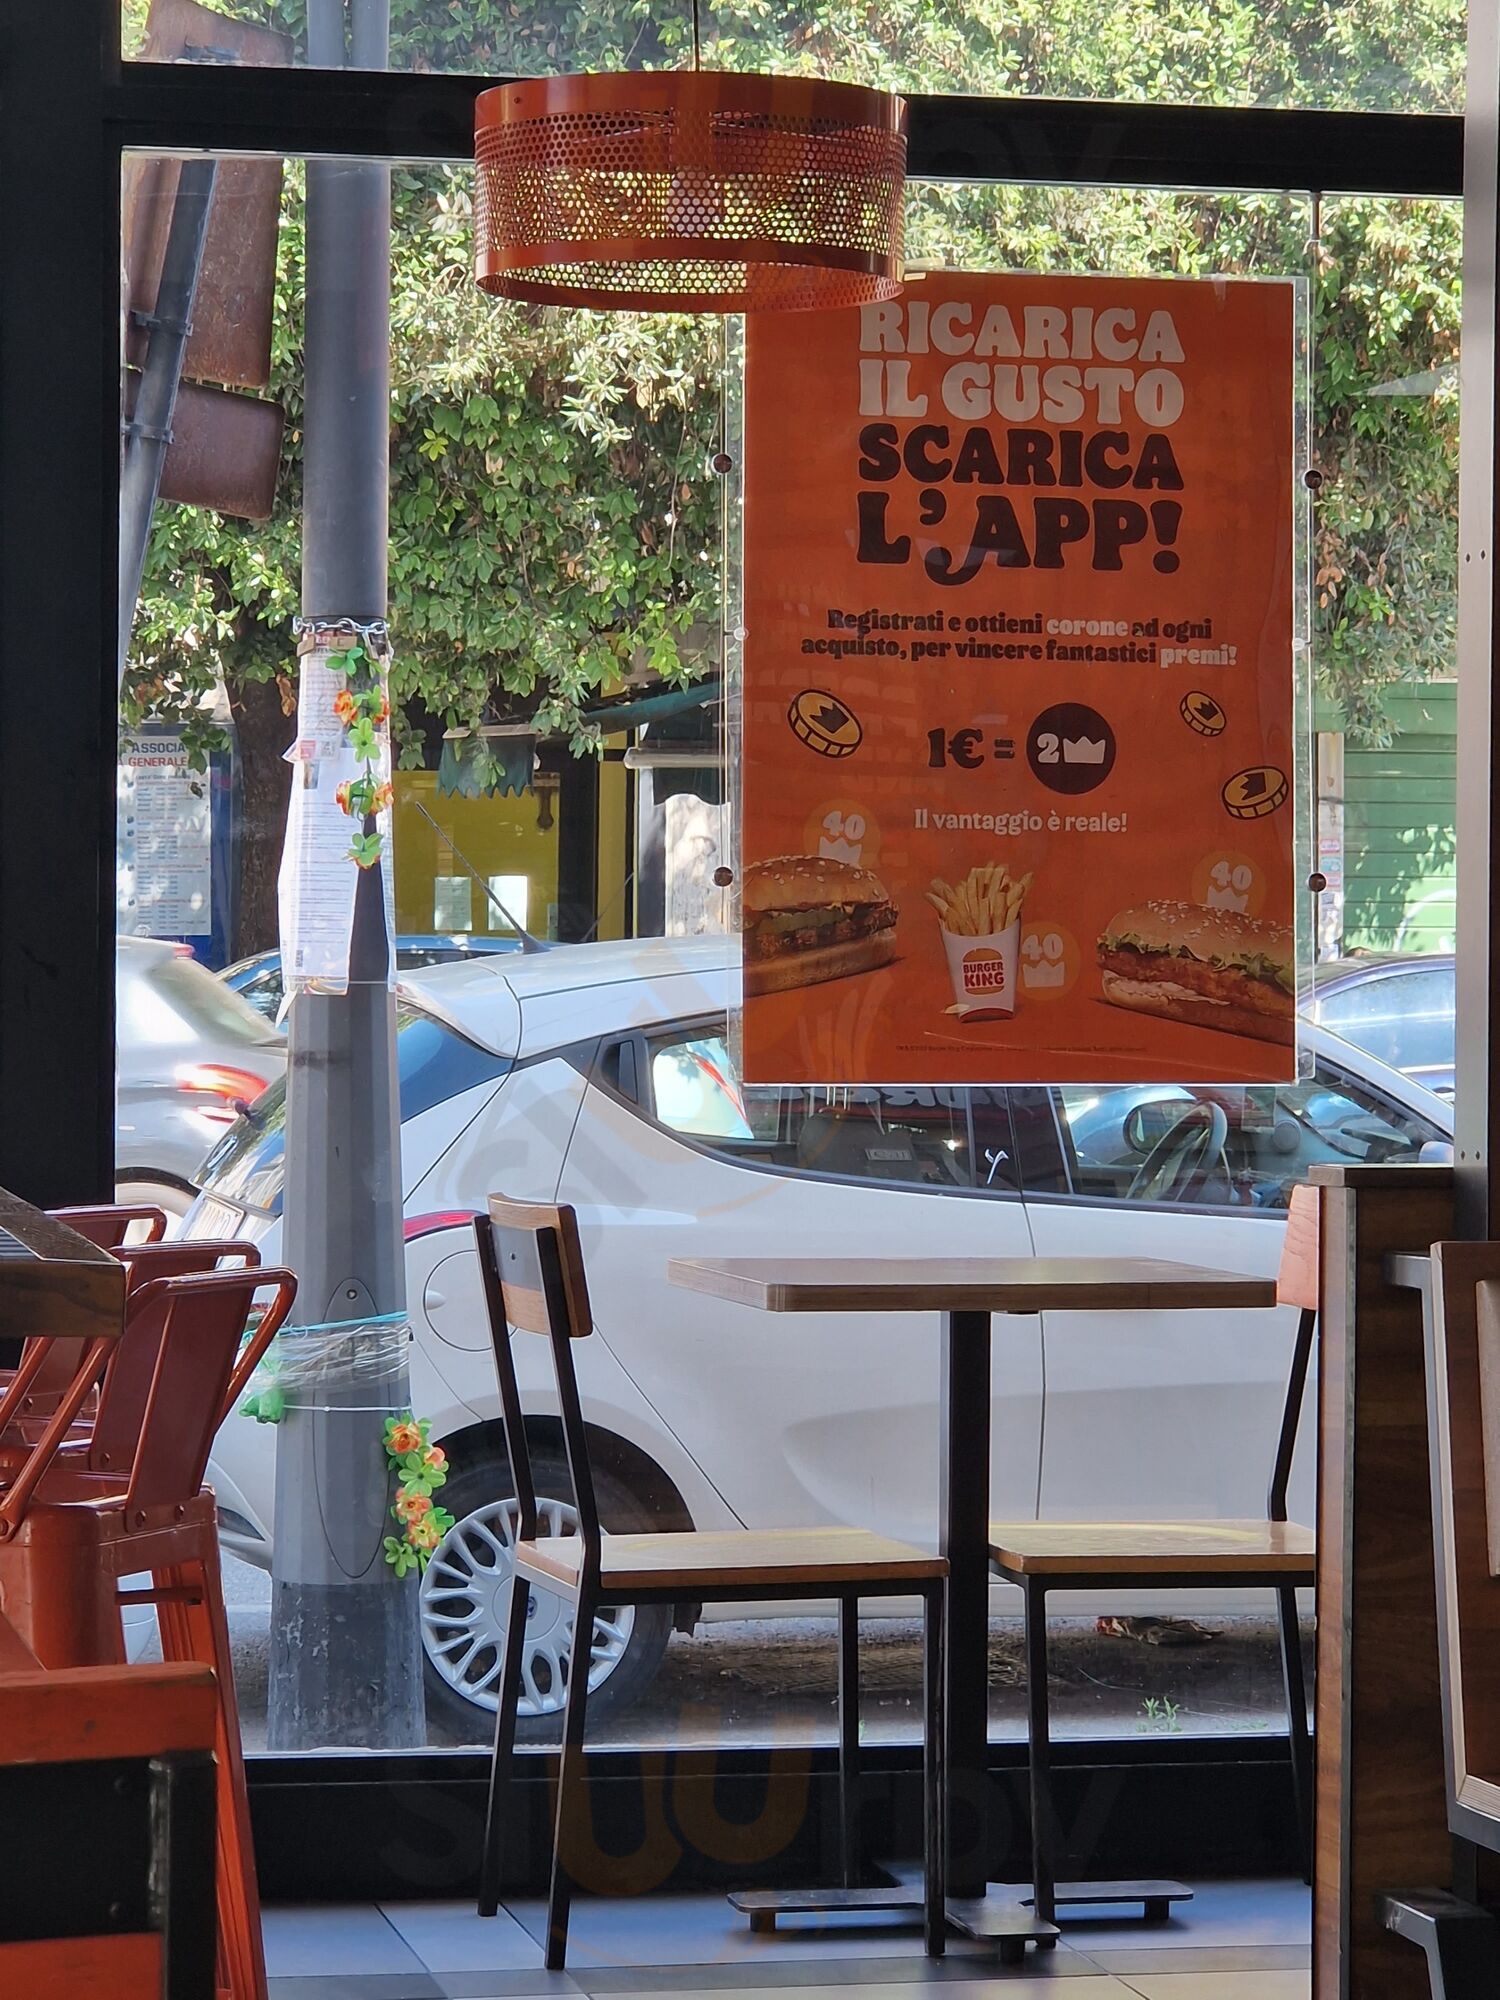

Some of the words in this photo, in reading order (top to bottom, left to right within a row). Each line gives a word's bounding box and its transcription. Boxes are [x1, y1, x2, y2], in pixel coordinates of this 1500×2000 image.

[859, 301, 1185, 361] RICARICA
[859, 359, 928, 417] IL
[942, 362, 1184, 427] GUSTO
[859, 424, 1184, 490] SCARICA
[857, 489, 1184, 586] L'APP!
[828, 610, 944, 636] Registrati
[948, 617, 961, 632] e
[965, 612, 1042, 633] ottieni
[1047, 619, 1128, 636] corone
[1132, 618, 1159, 637] ad
[1163, 618, 1212, 643] ogni
[801, 637, 907, 660] acquisto,
[911, 642, 951, 661] per
[955, 637, 1042, 660] vincere
[1046, 639, 1156, 663] fantastici
[1161, 644, 1236, 668] premi!
[128, 756, 188, 768] GENERALE
[928, 728, 984, 769] 1€
[1038, 733, 1059, 763] 2
[823, 811, 865, 840] 40
[915, 809, 927, 828] Il
[933, 810, 1042, 835] vantaggio
[1048, 810, 1060, 831] è
[1066, 812, 1126, 832] reale!
[1208, 861, 1252, 891] 40
[1021, 934, 1062, 960] 40
[963, 961, 1004, 974] BURGER
[964, 972, 1004, 987] KING
